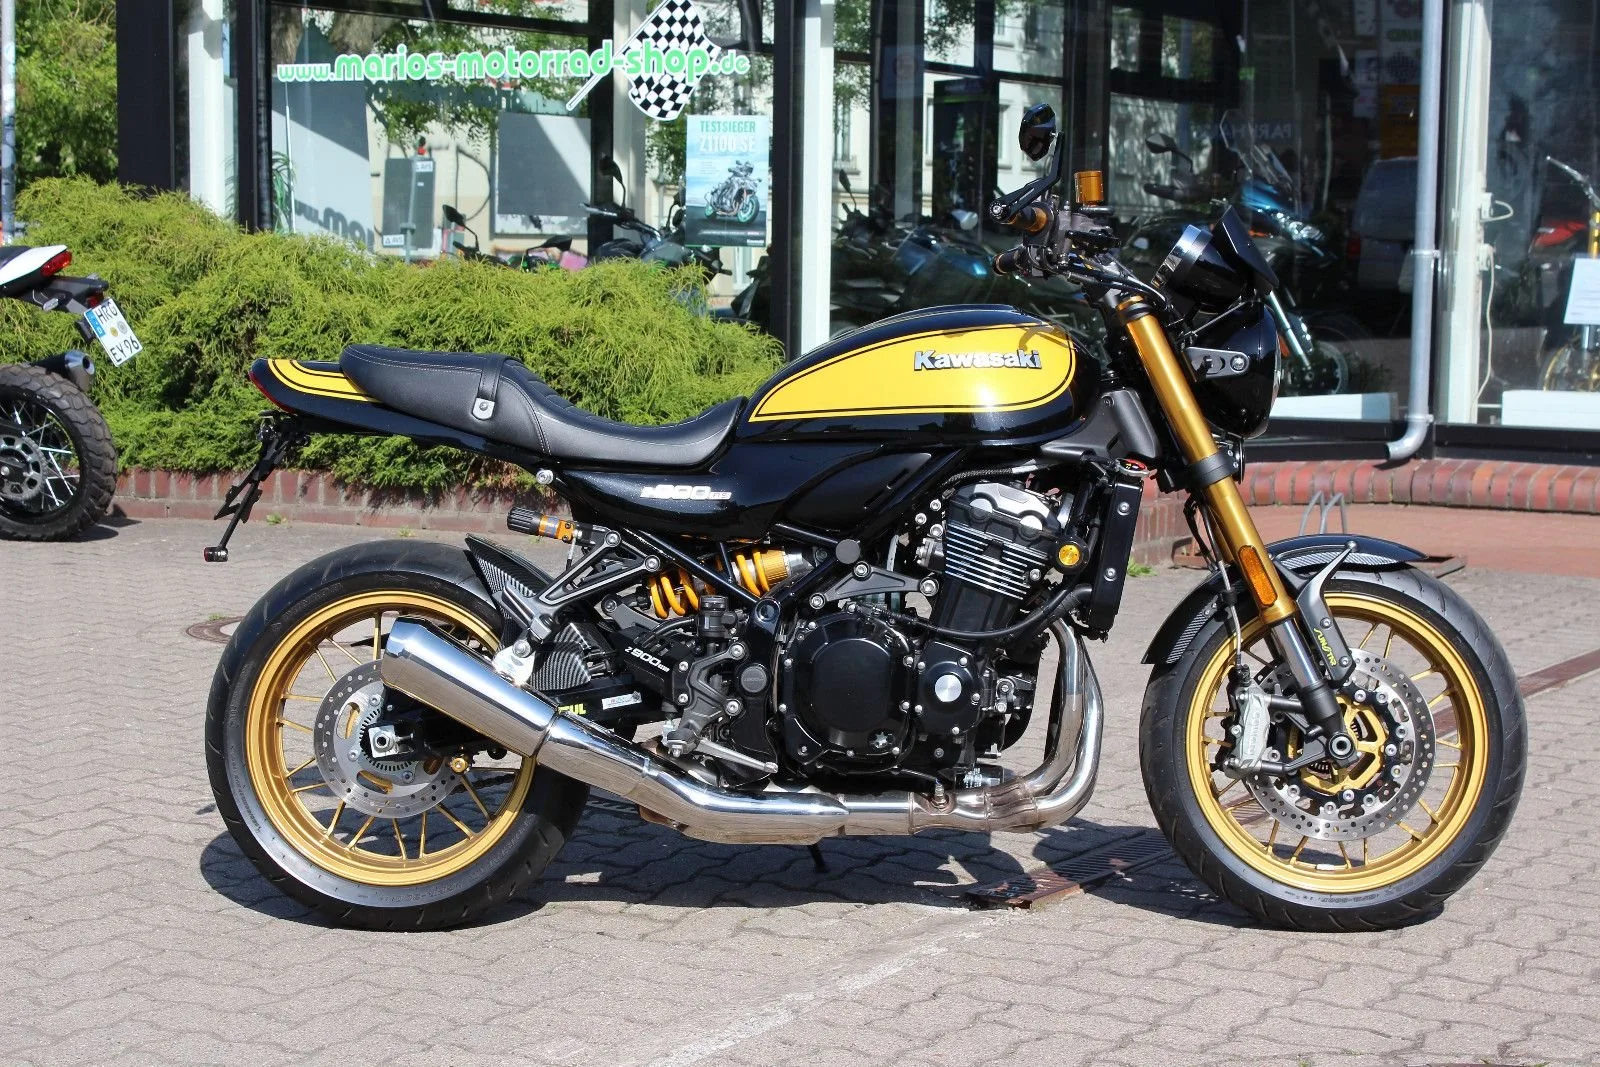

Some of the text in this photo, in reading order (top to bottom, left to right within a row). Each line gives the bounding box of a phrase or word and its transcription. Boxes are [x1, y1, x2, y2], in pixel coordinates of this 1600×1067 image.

[277, 40, 750, 85] www.marios-motorrad-shop.de
[700, 121, 756, 132] TESTSIEGER
[914, 349, 1042, 371] Kawasaki
